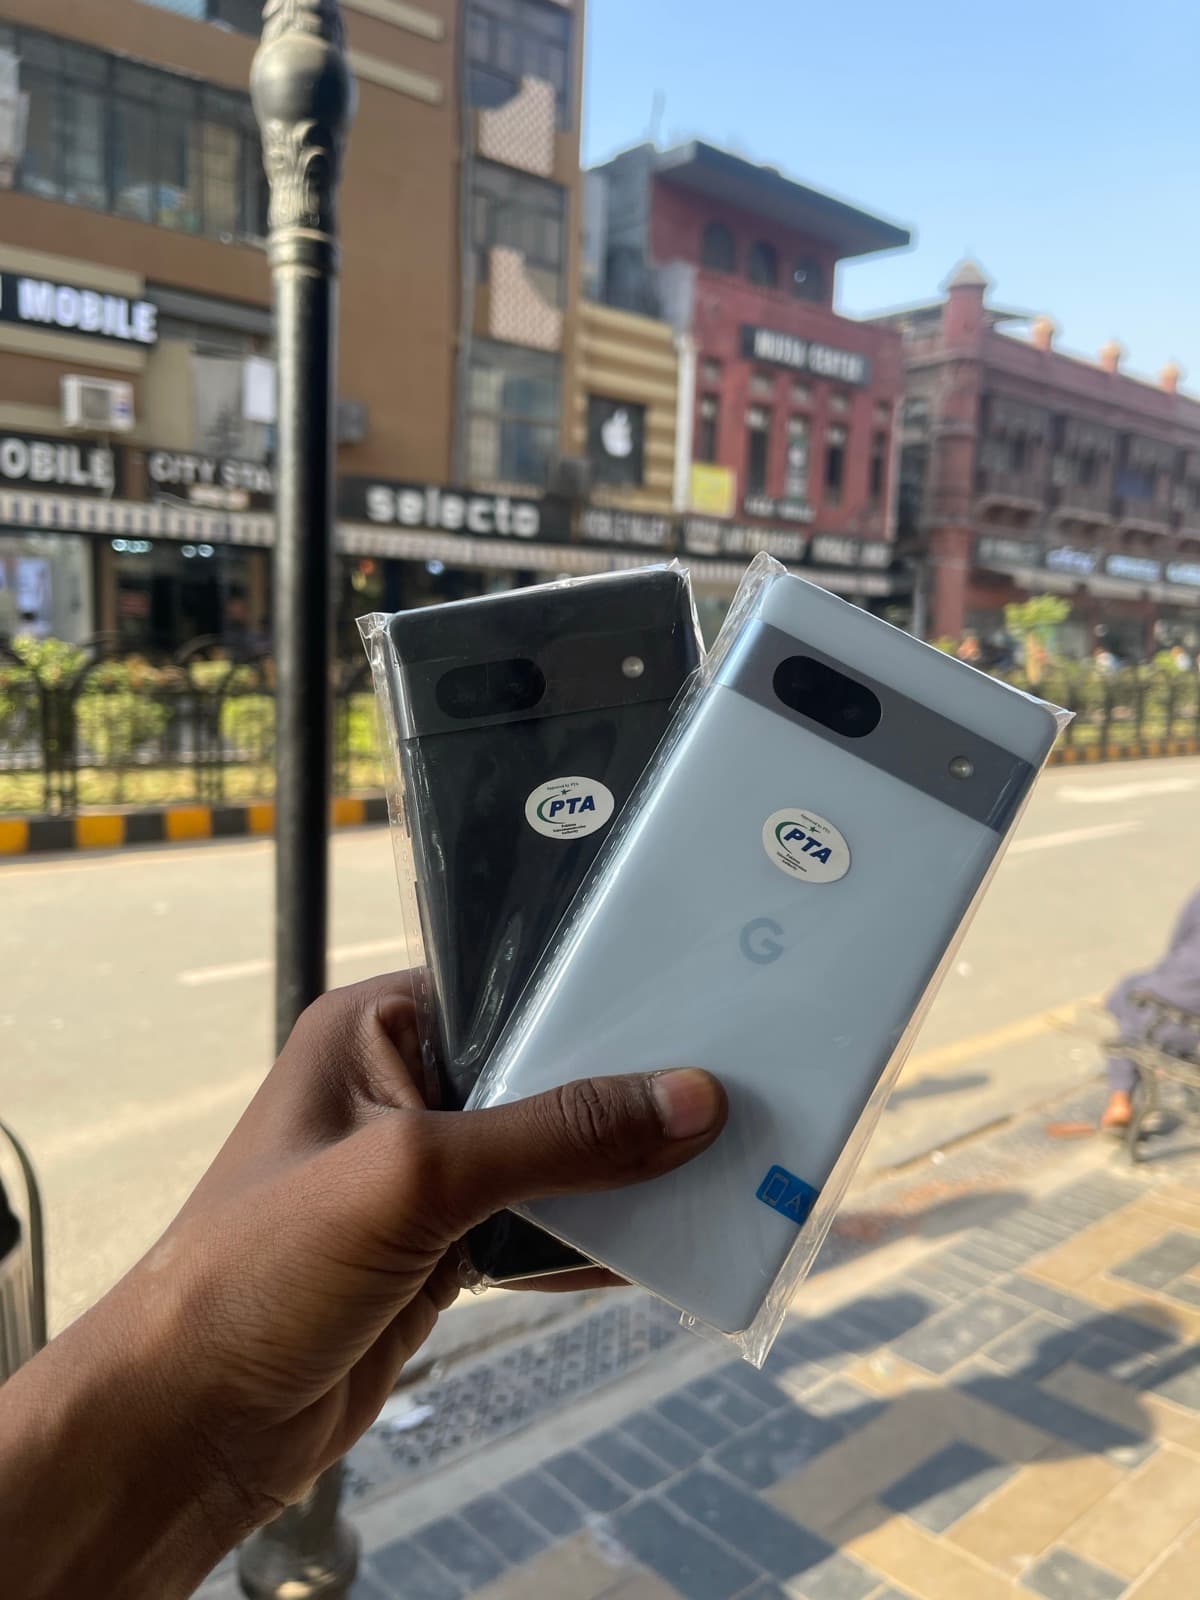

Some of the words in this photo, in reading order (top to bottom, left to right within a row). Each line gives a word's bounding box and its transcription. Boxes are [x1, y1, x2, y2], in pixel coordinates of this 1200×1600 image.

[18, 278, 158, 343] MOBILE
[0, 437, 115, 488] OBILE
[150, 451, 216, 485] CITY
[549, 795, 595, 818] PTA
[783, 828, 833, 865] PTA
[739, 917, 785, 965] G
